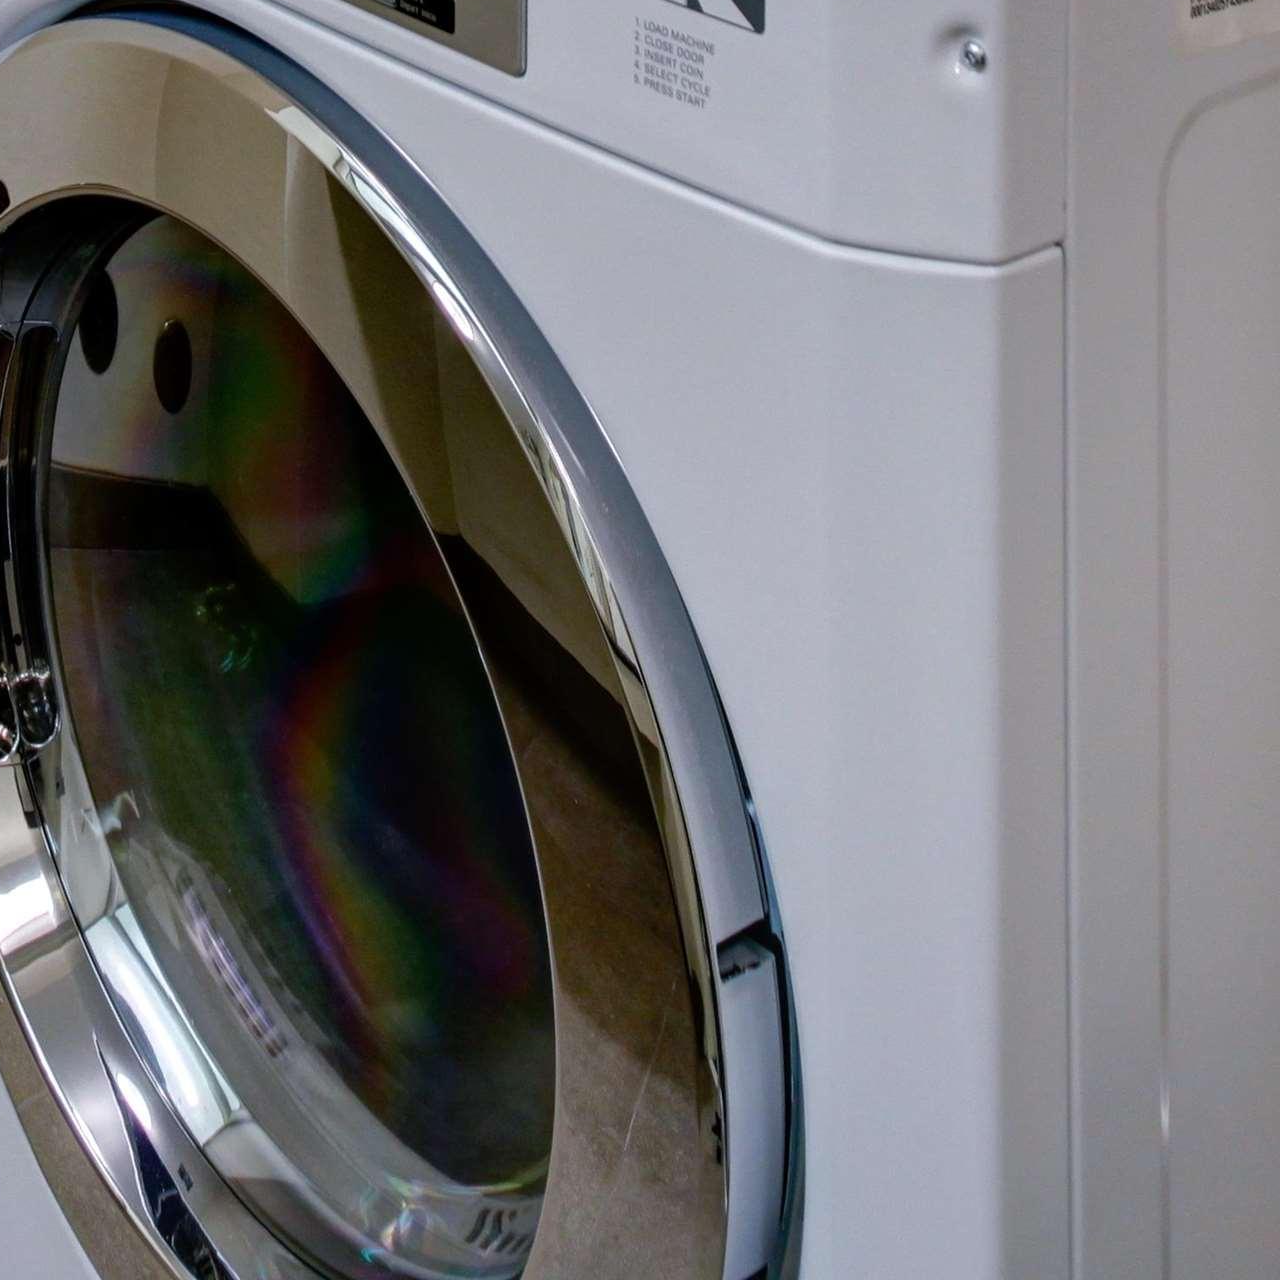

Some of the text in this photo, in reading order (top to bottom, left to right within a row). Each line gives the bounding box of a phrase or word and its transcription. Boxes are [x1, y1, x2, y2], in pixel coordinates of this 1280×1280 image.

[643, 19, 669, 37] LOAD
[671, 28, 715, 56] MACHINE
[644, 33, 674, 54] CLOSE
[676, 46, 705, 66] DOOR
[643, 47, 677, 70] INSERT
[680, 61, 704, 81] COIN
[644, 62, 678, 85] SELECT
[680, 77, 711, 98] CYCLE
[643, 75, 674, 99] PRESS
[675, 88, 706, 110] START
